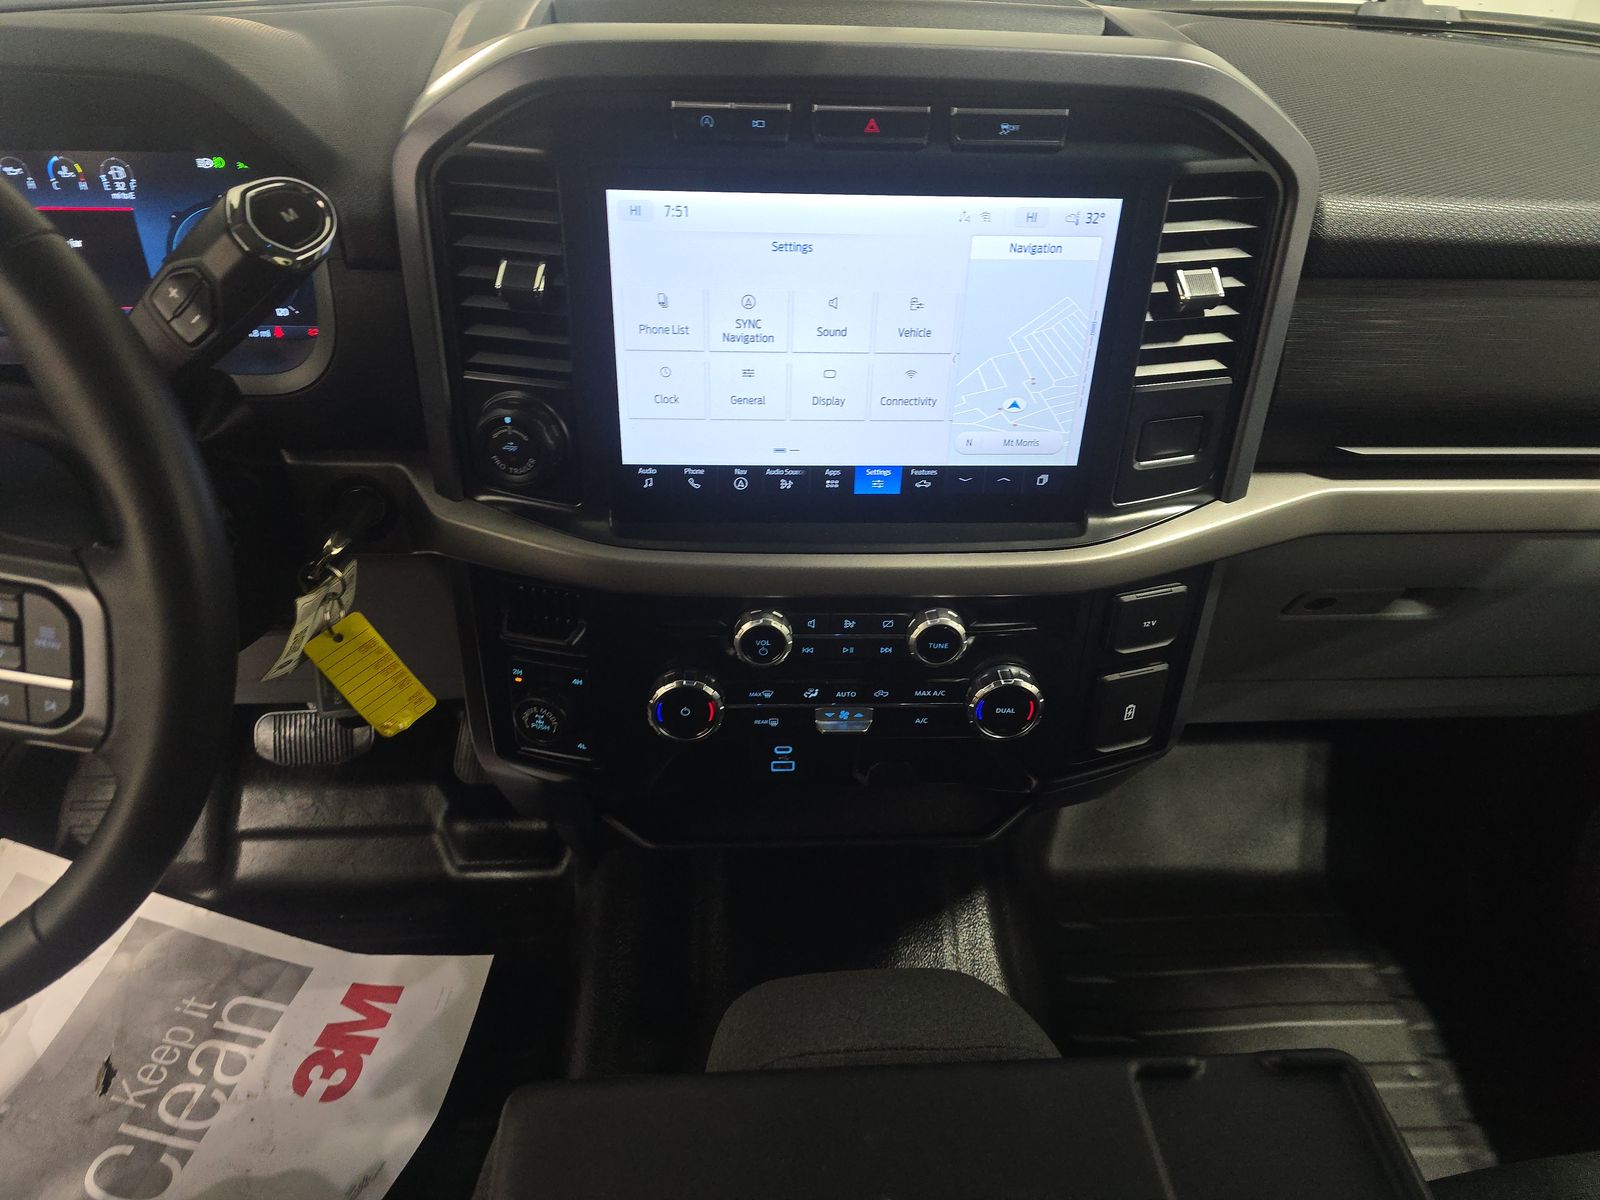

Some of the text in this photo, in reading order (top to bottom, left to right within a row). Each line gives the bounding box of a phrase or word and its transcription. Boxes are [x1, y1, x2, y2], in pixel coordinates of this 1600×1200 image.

[629, 205, 642, 216] HI
[663, 205, 690, 218] 7:51
[1026, 212, 1038, 223] HI
[1085, 212, 1106, 224] 32°
[771, 241, 814, 255] Settings
[1009, 242, 1063, 255] Navigation
[735, 318, 762, 330] SYNC
[638, 324, 690, 336] Phone List
[816, 326, 848, 338] Sound
[898, 327, 932, 338] Vehicle
[722, 331, 775, 344] Navigation
[653, 393, 680, 405] Clock
[730, 395, 766, 406] General
[811, 395, 847, 408] Display
[879, 395, 938, 408] Connectivity
[966, 438, 973, 447] N
[1002, 438, 1040, 448] Mt Morris
[637, 467, 658, 475] Audio
[683, 467, 705, 476] Phone
[734, 467, 748, 476] Nav
[765, 467, 784, 476] Audio
[824, 468, 841, 477] Apps
[865, 467, 892, 477] Settings
[910, 468, 938, 476] Features
[755, 639, 771, 647] VOL
[928, 642, 950, 650] TUNE
[836, 690, 857, 698] AUTO
[914, 689, 946, 697] MAX A/C
[995, 707, 1016, 715] DUAL
[915, 716, 929, 725] A/C
[292, 982, 405, 1103] 3M
[110, 995, 217, 1111] Keep it
[84, 994, 290, 1200] Clean
